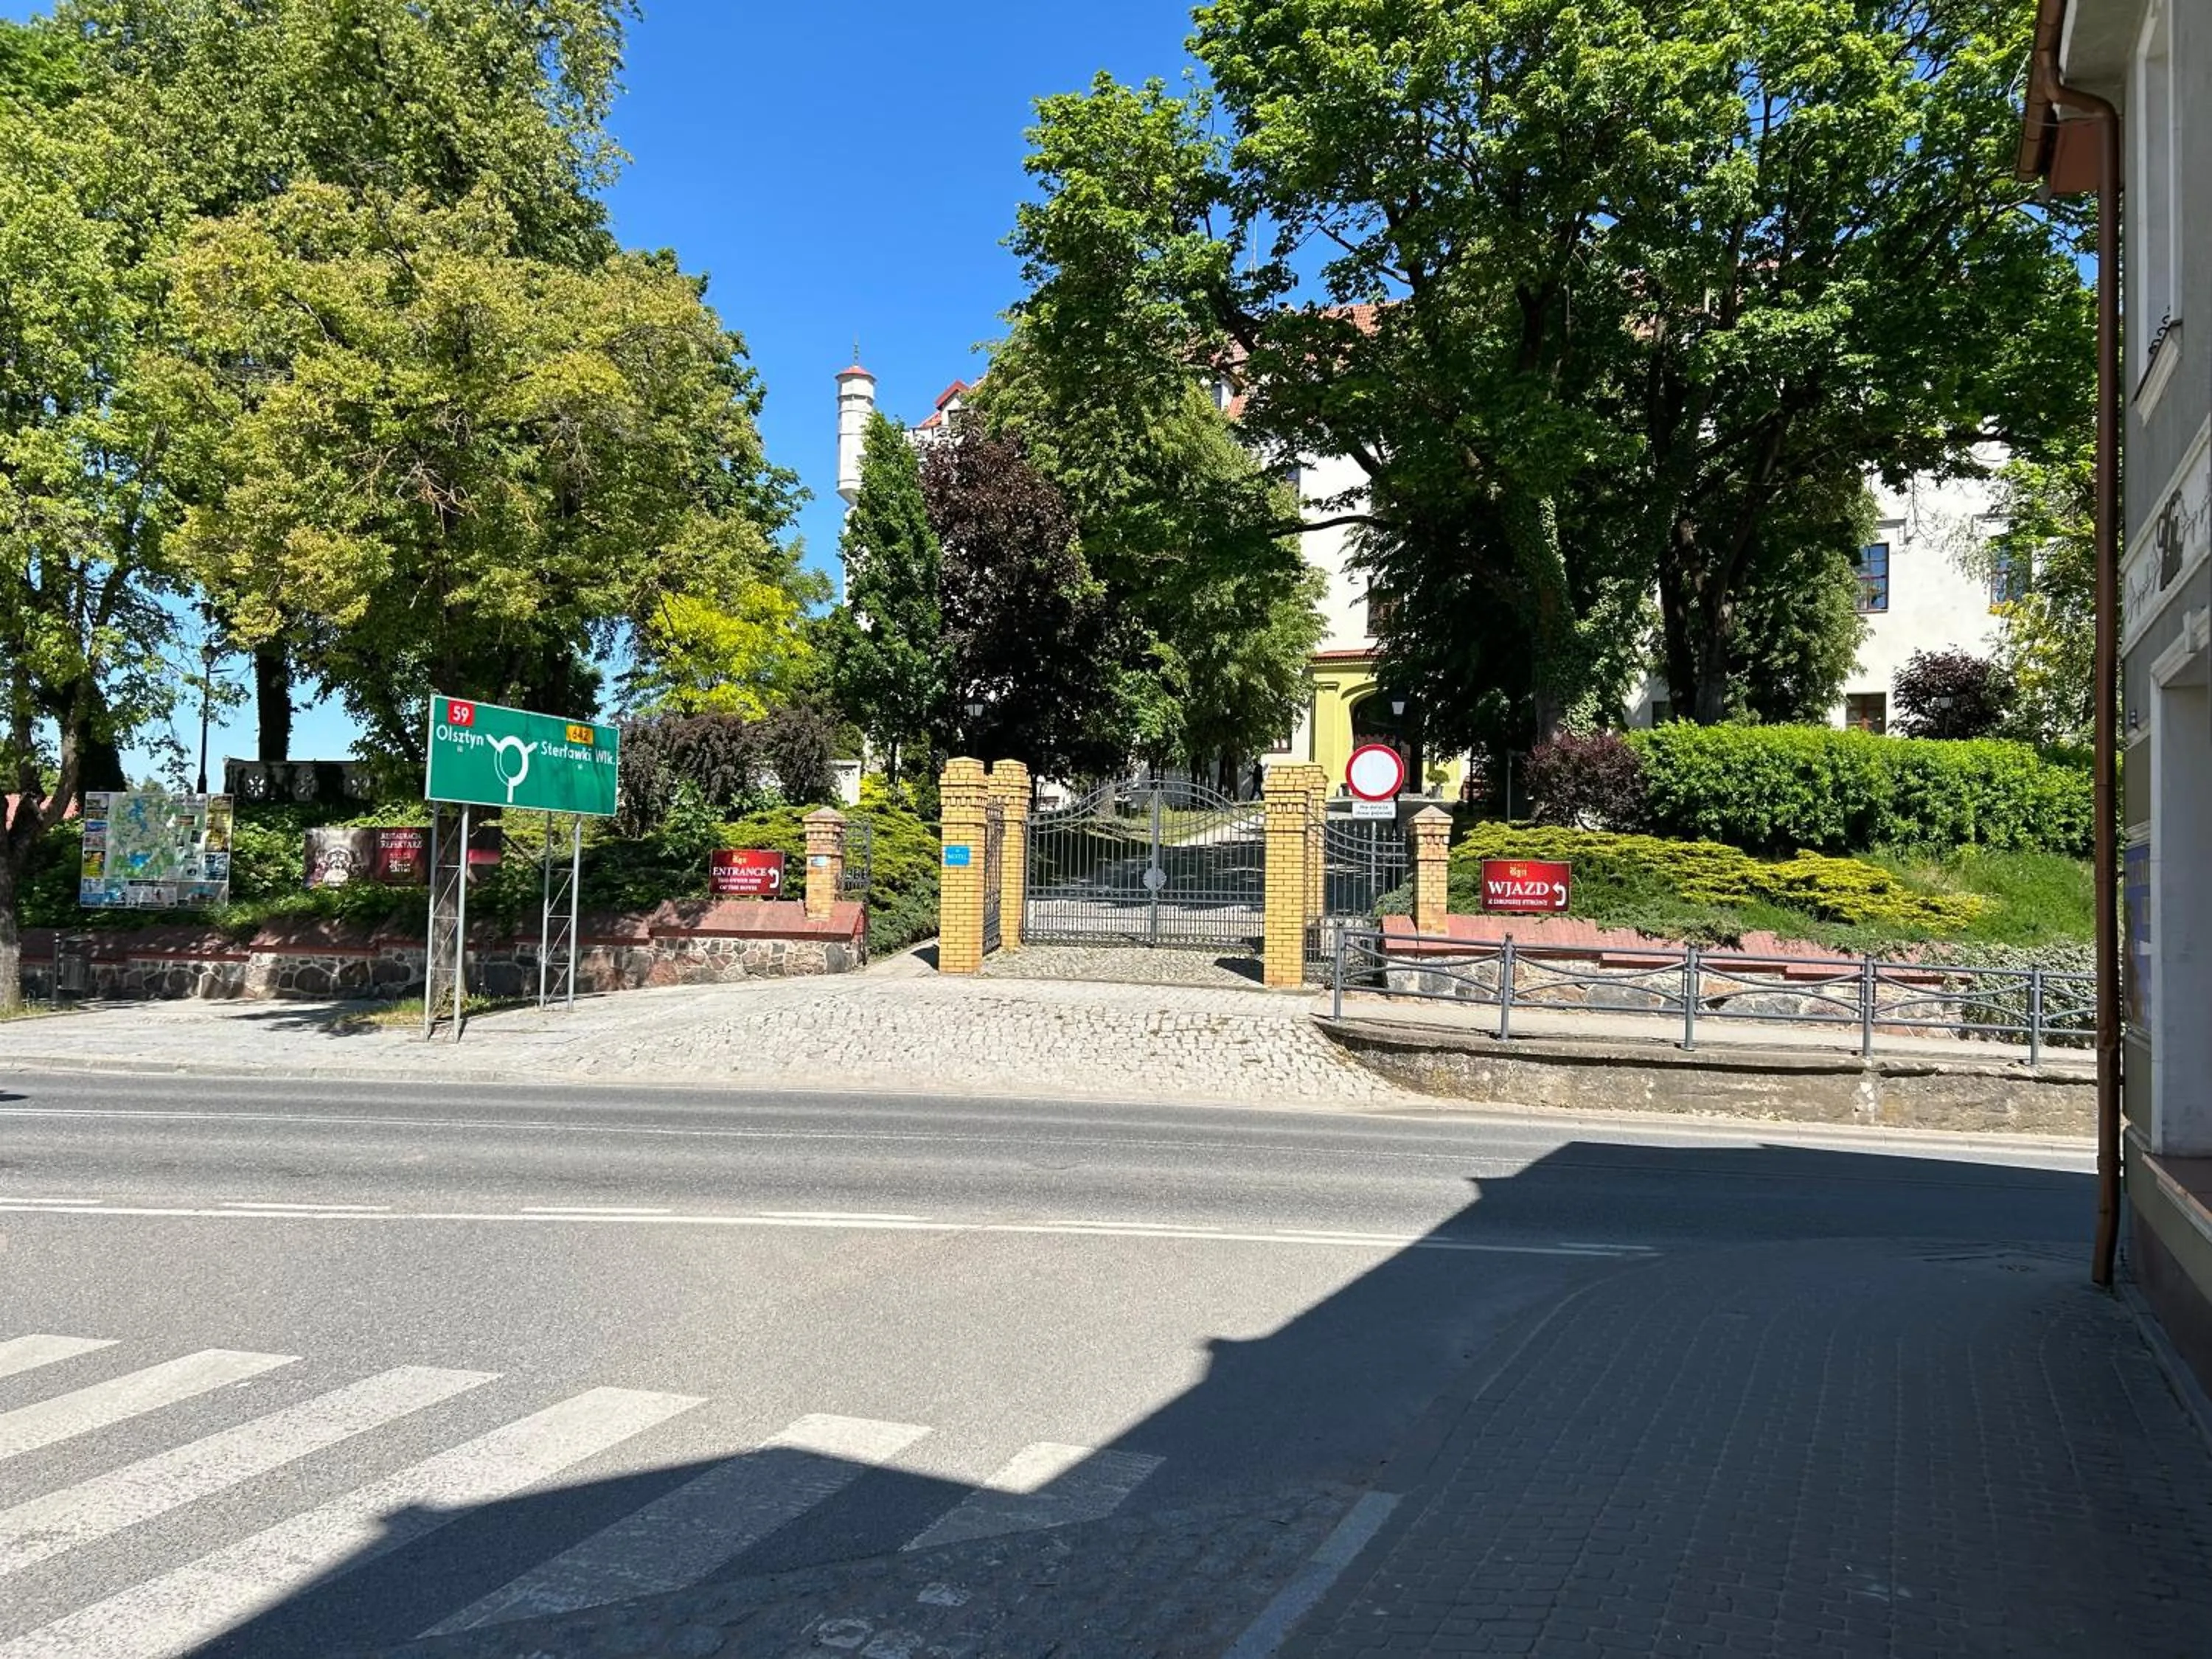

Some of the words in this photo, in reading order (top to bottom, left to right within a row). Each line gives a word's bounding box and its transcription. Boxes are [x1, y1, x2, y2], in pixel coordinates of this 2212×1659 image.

[453, 706, 470, 723] 59
[437, 724, 484, 750] Olsztyn
[572, 727, 589, 741] 642
[712, 866, 768, 877] ENTRANCE
[1488, 880, 1549, 897] WJAZD
